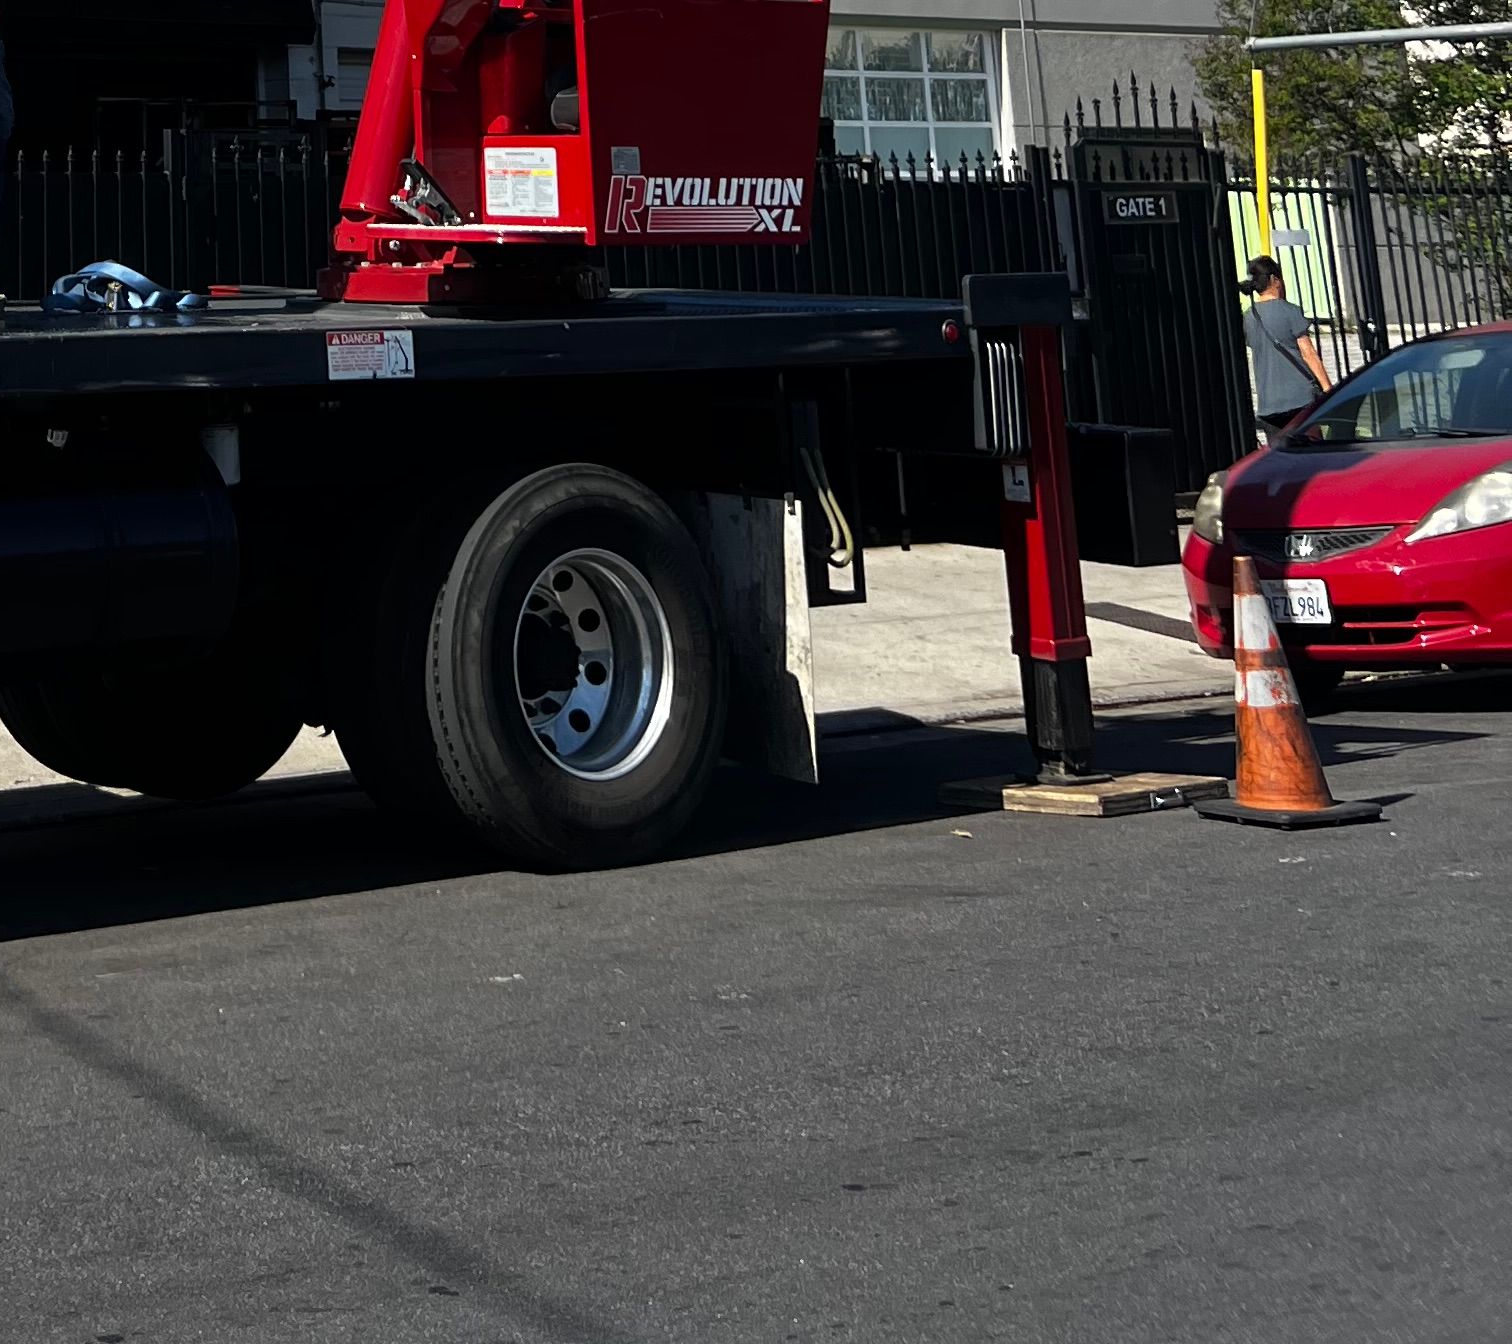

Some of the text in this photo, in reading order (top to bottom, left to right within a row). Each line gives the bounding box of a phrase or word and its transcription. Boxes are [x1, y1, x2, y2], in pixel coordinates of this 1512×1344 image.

[604, 175, 804, 233] REVOLUTION
[1116, 197, 1166, 217] GATE 1
[754, 208, 801, 232] XL
[341, 333, 380, 344] DANGER
